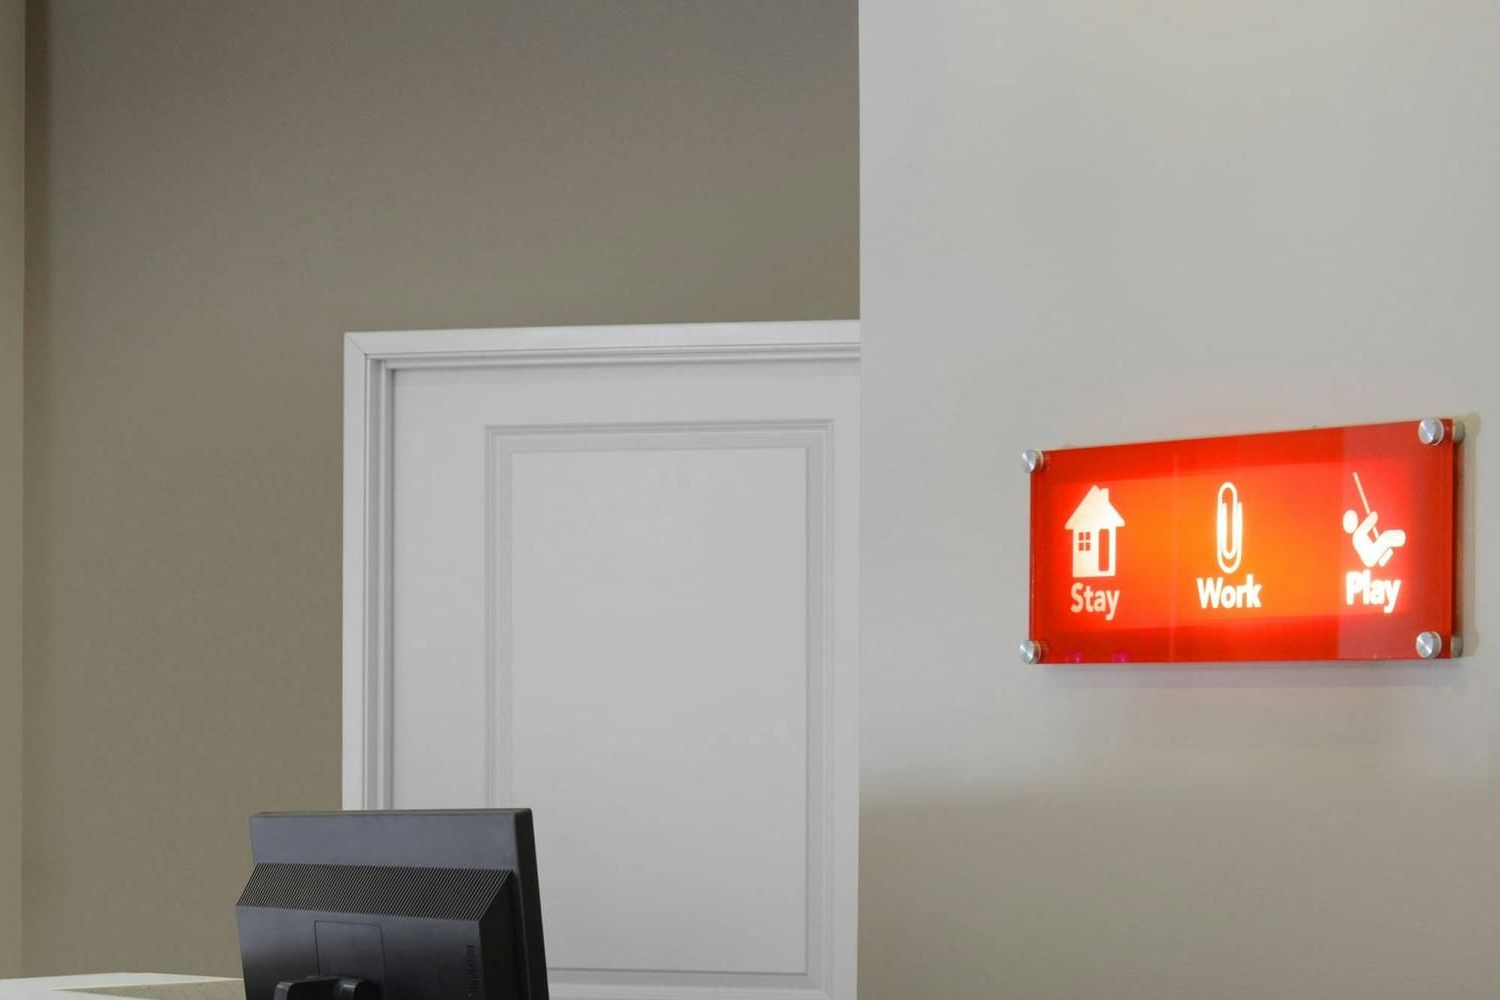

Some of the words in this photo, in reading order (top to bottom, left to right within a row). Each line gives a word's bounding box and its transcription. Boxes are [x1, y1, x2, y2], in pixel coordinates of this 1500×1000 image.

[1070, 582, 1120, 621] Stay
[1196, 574, 1262, 609] Work
[1345, 569, 1401, 614] Play
